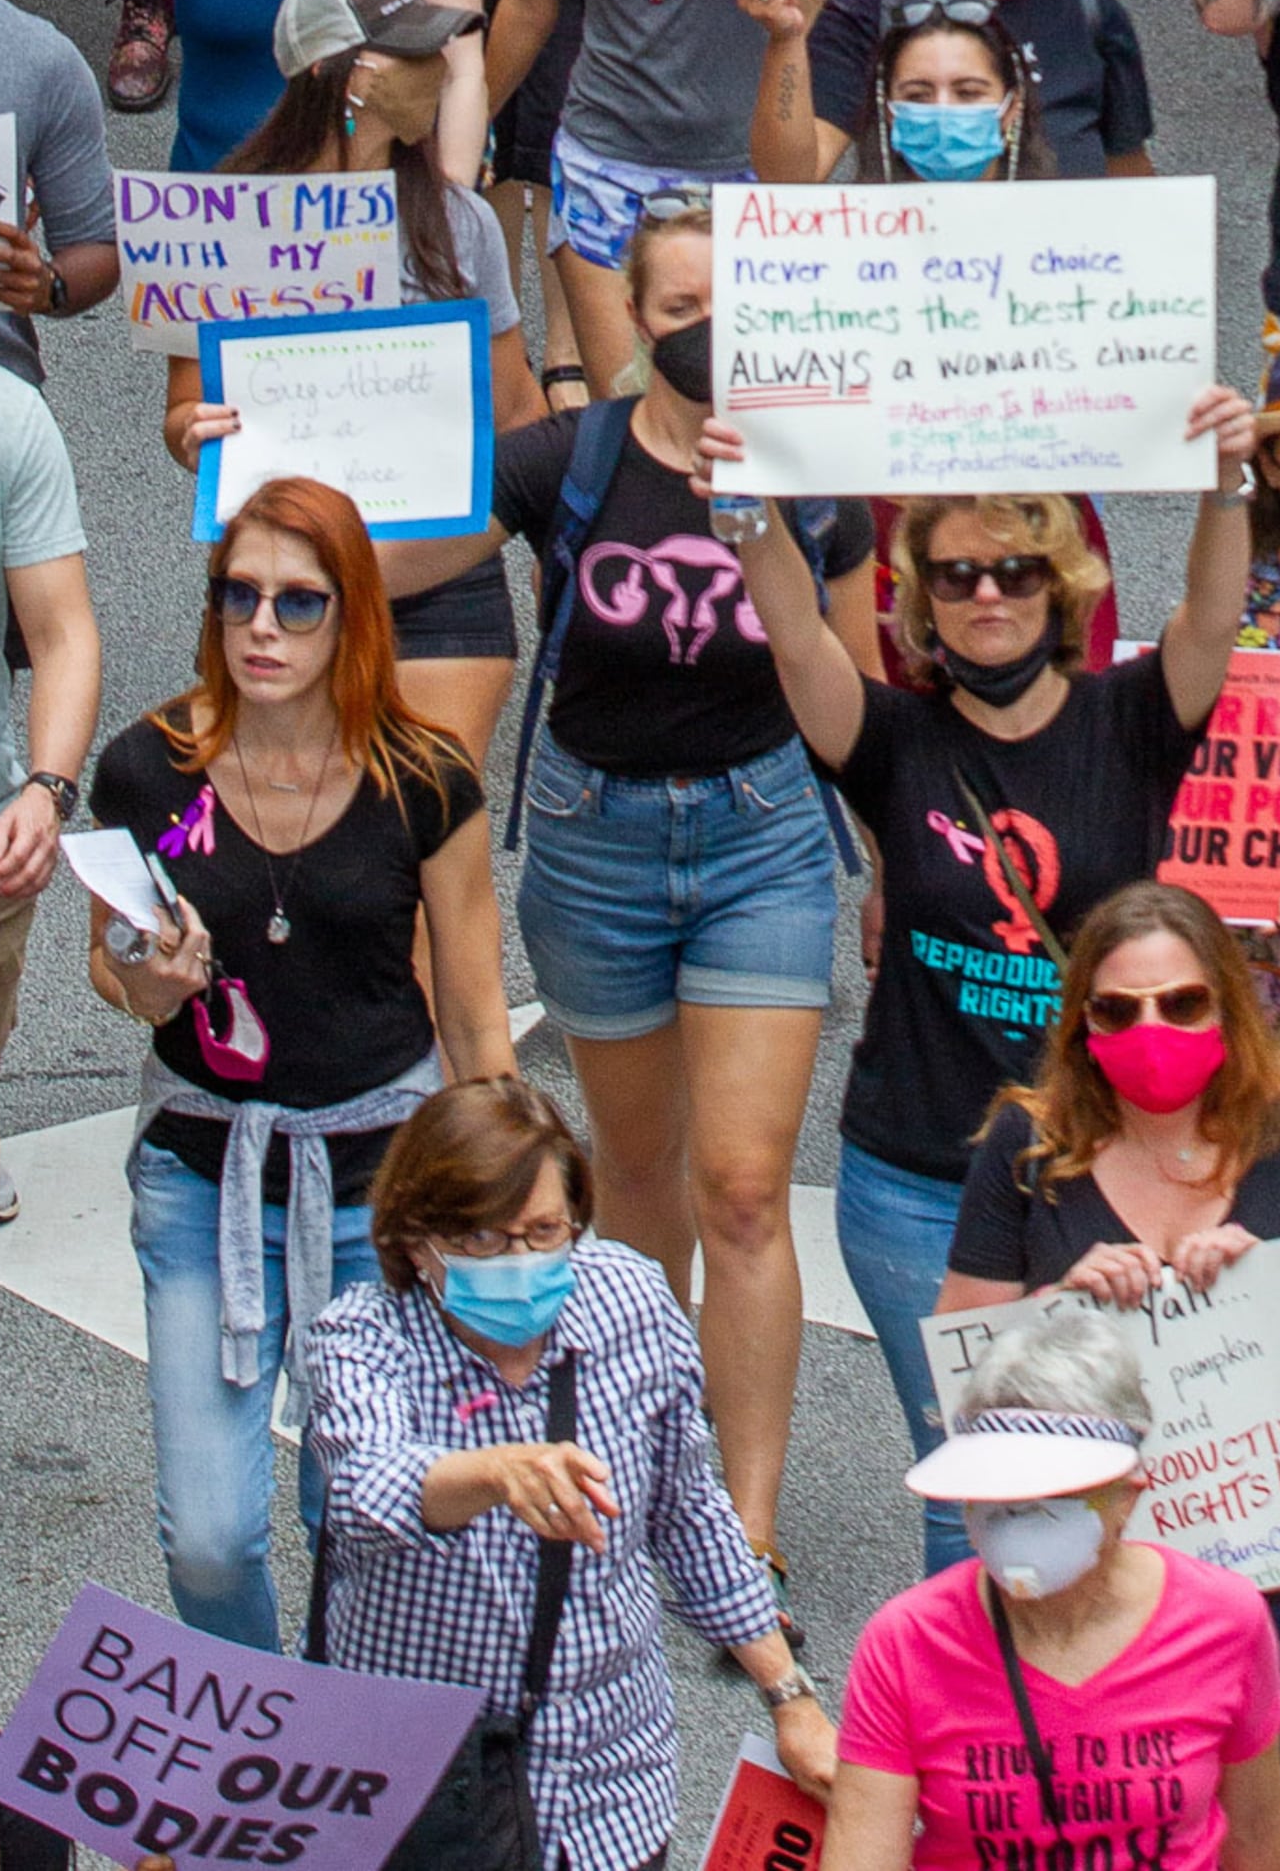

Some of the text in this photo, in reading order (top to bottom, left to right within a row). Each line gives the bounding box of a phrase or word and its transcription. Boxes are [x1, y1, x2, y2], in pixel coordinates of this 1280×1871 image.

[121, 177, 395, 232] DON'T MESS
[735, 191, 937, 239] Abortion:
[123, 240, 326, 270] WITH MY
[733, 247, 1124, 299] never an easy choice
[131, 267, 375, 328] ACCESS!
[734, 285, 1208, 336] sometimes the best choice
[728, 350, 871, 396] ALWAYS
[892, 361, 914, 380] a
[1097, 341, 1199, 367] choice
[80, 1624, 297, 1742] BANS
[54, 1688, 390, 1818] OFF OUR
[17, 1736, 321, 1866] BODIES
